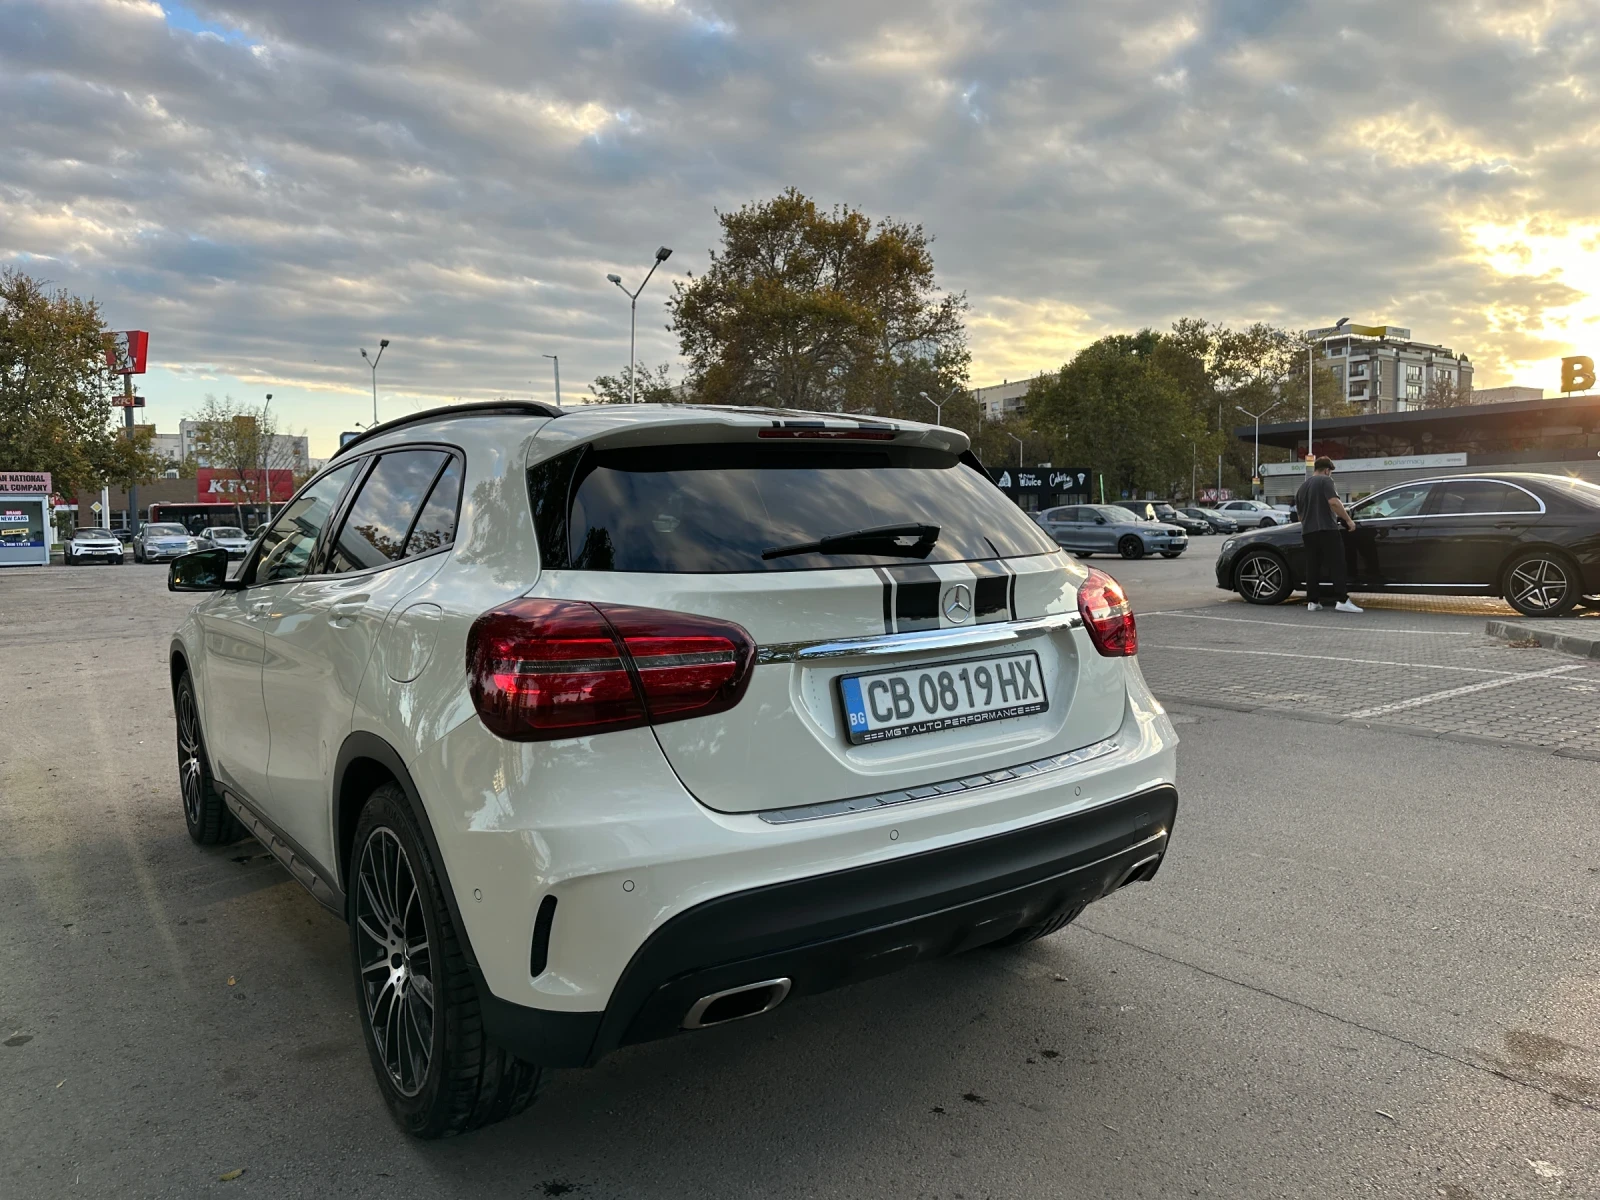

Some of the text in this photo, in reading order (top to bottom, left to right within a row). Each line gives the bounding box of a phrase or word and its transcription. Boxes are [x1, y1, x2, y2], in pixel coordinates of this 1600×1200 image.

[114, 397, 131, 405] KFC
[207, 479, 256, 493] KFC
[1024, 478, 1042, 487] Juice
[868, 660, 1039, 723] CB 0819 HX
[850, 712, 866, 726] BG
[885, 706, 1024, 738] MGT AUTO PERFORMANCE
